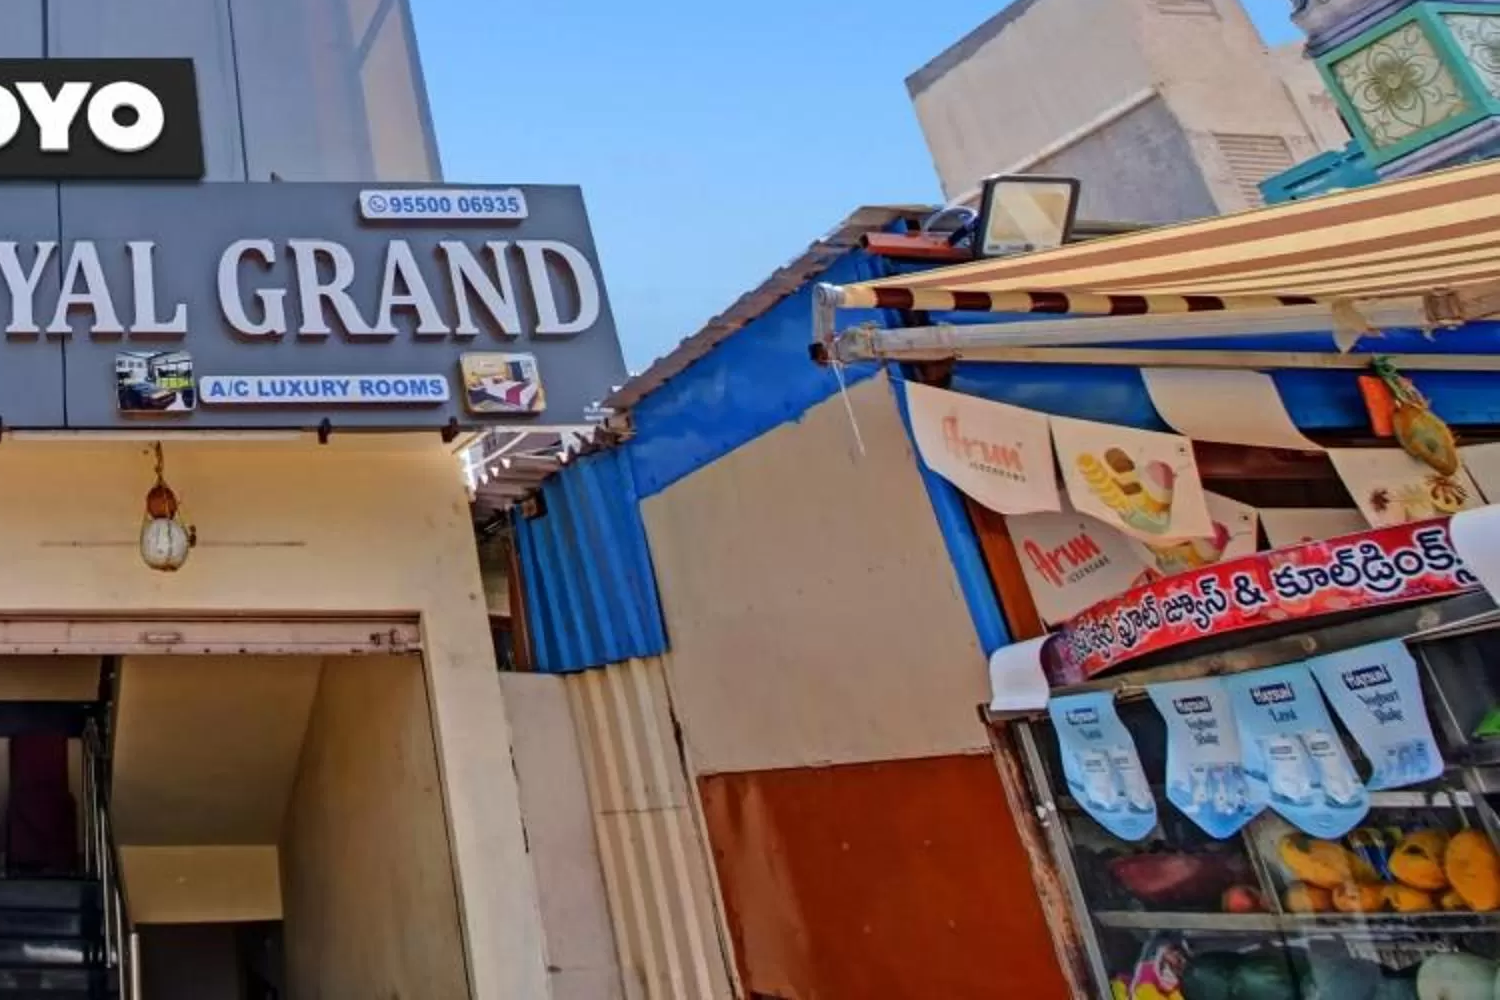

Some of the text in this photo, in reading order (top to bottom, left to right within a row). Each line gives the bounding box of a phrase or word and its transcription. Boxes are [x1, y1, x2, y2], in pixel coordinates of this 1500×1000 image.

[389, 196, 520, 213] 95500 06935
[217, 237, 600, 337] GRAND
[210, 378, 444, 397] A/C LUXURY ROOMS
[942, 414, 1025, 472] Arun
[1022, 532, 1101, 588] Arun
